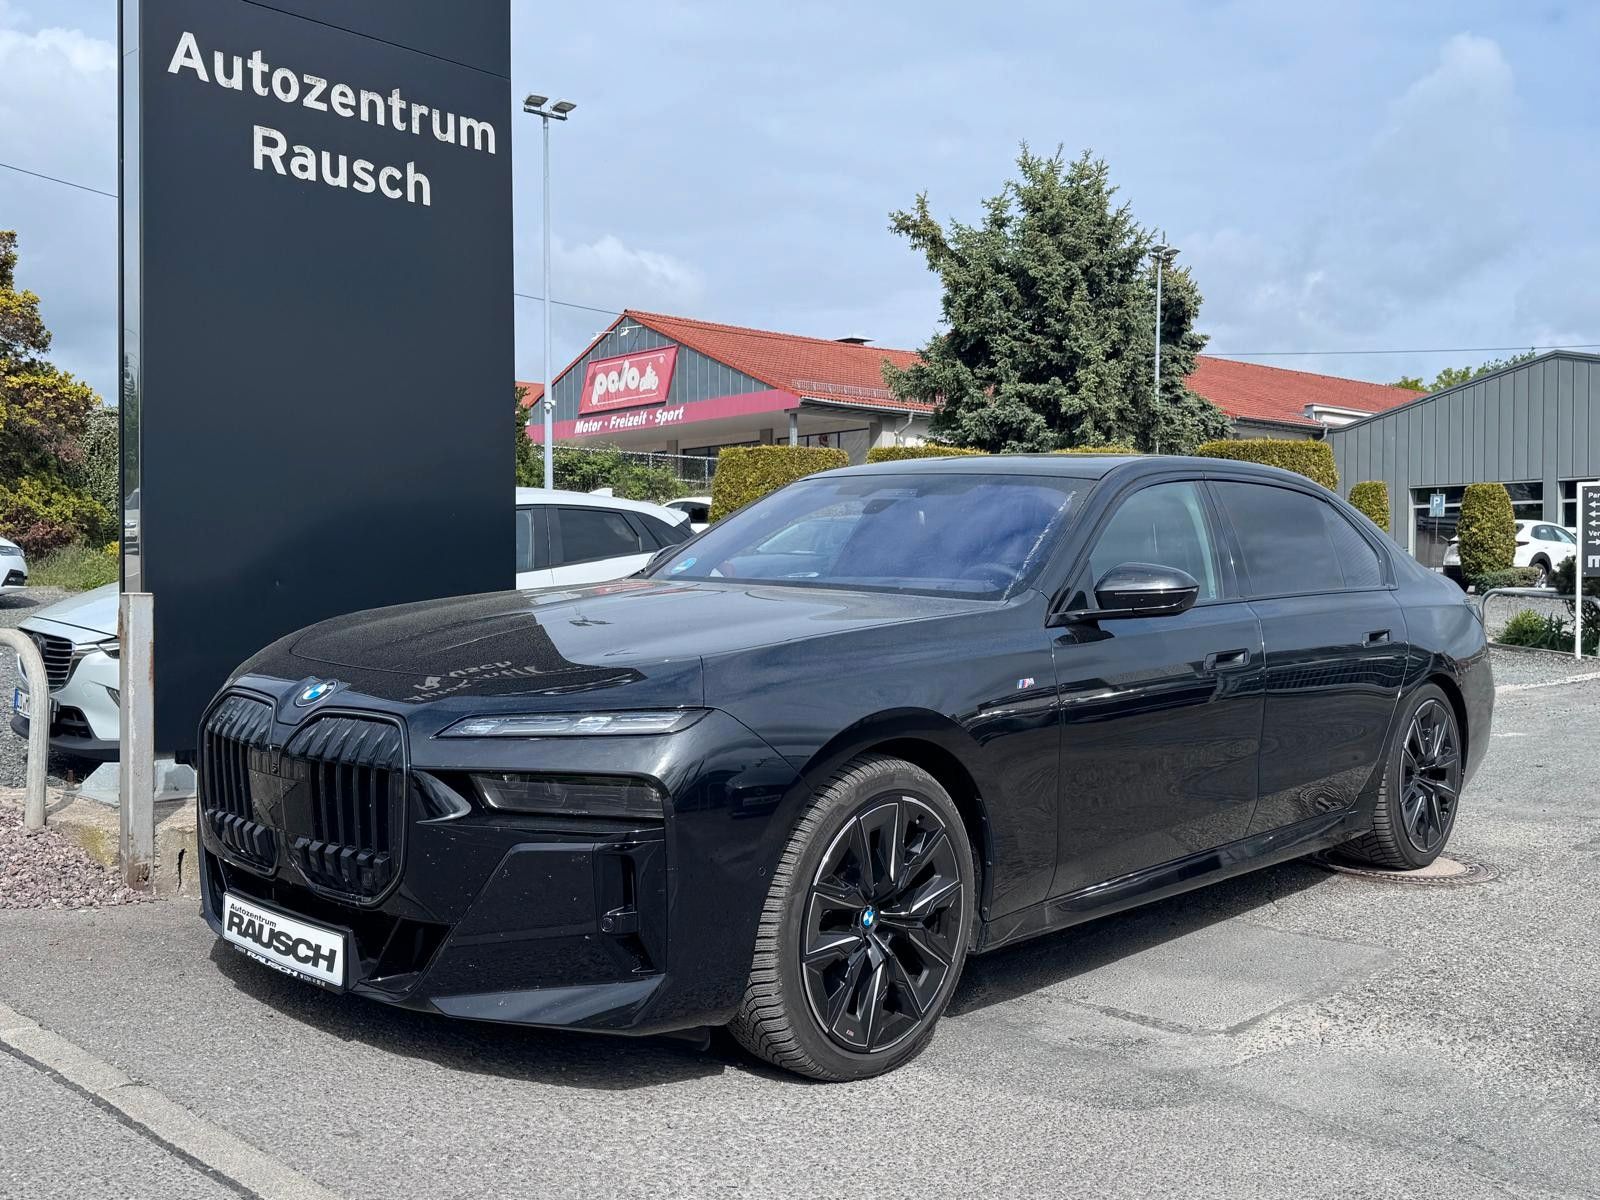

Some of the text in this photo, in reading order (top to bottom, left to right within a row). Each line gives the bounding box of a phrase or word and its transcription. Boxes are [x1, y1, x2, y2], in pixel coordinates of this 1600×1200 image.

[167, 31, 496, 154] Autozentrum
[253, 124, 431, 206] Rausch
[591, 359, 640, 405] polo
[574, 406, 684, 434] Motor Freizeit Sport
[1434, 497, 1441, 506] P
[230, 903, 277, 928] Autozentrum
[227, 910, 337, 973] RAUSCH
